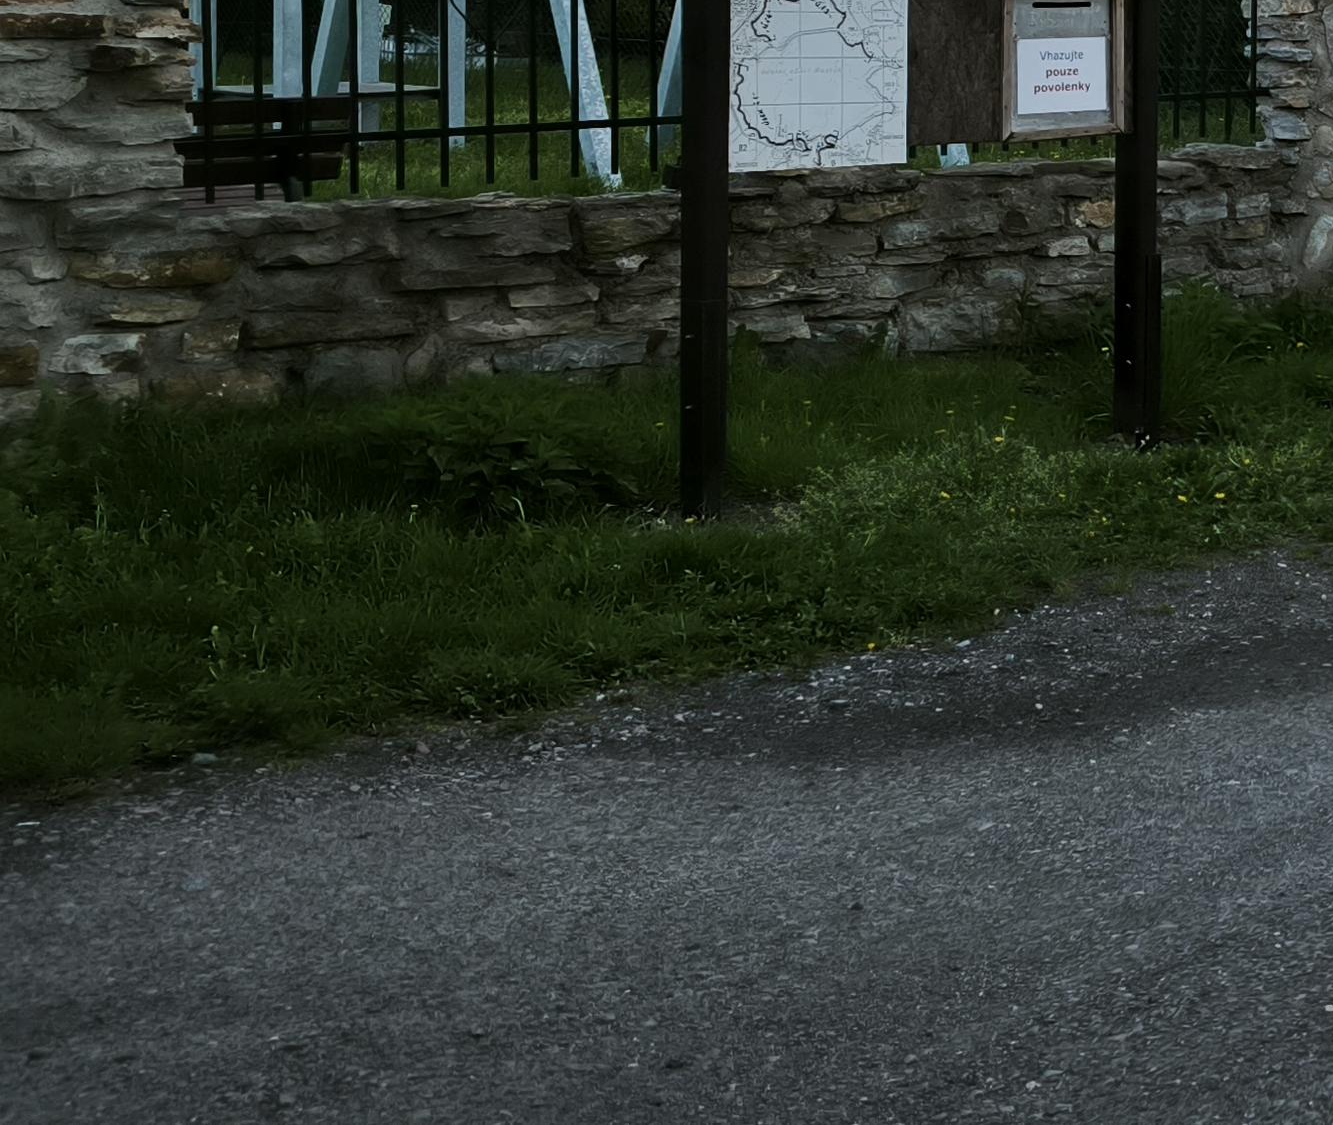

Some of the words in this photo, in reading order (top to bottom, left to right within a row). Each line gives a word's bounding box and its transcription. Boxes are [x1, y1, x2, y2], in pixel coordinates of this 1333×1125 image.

[1040, 50, 1084, 62] Vhazujte
[1046, 68, 1079, 78] pouze
[1034, 81, 1091, 95] povolenky
